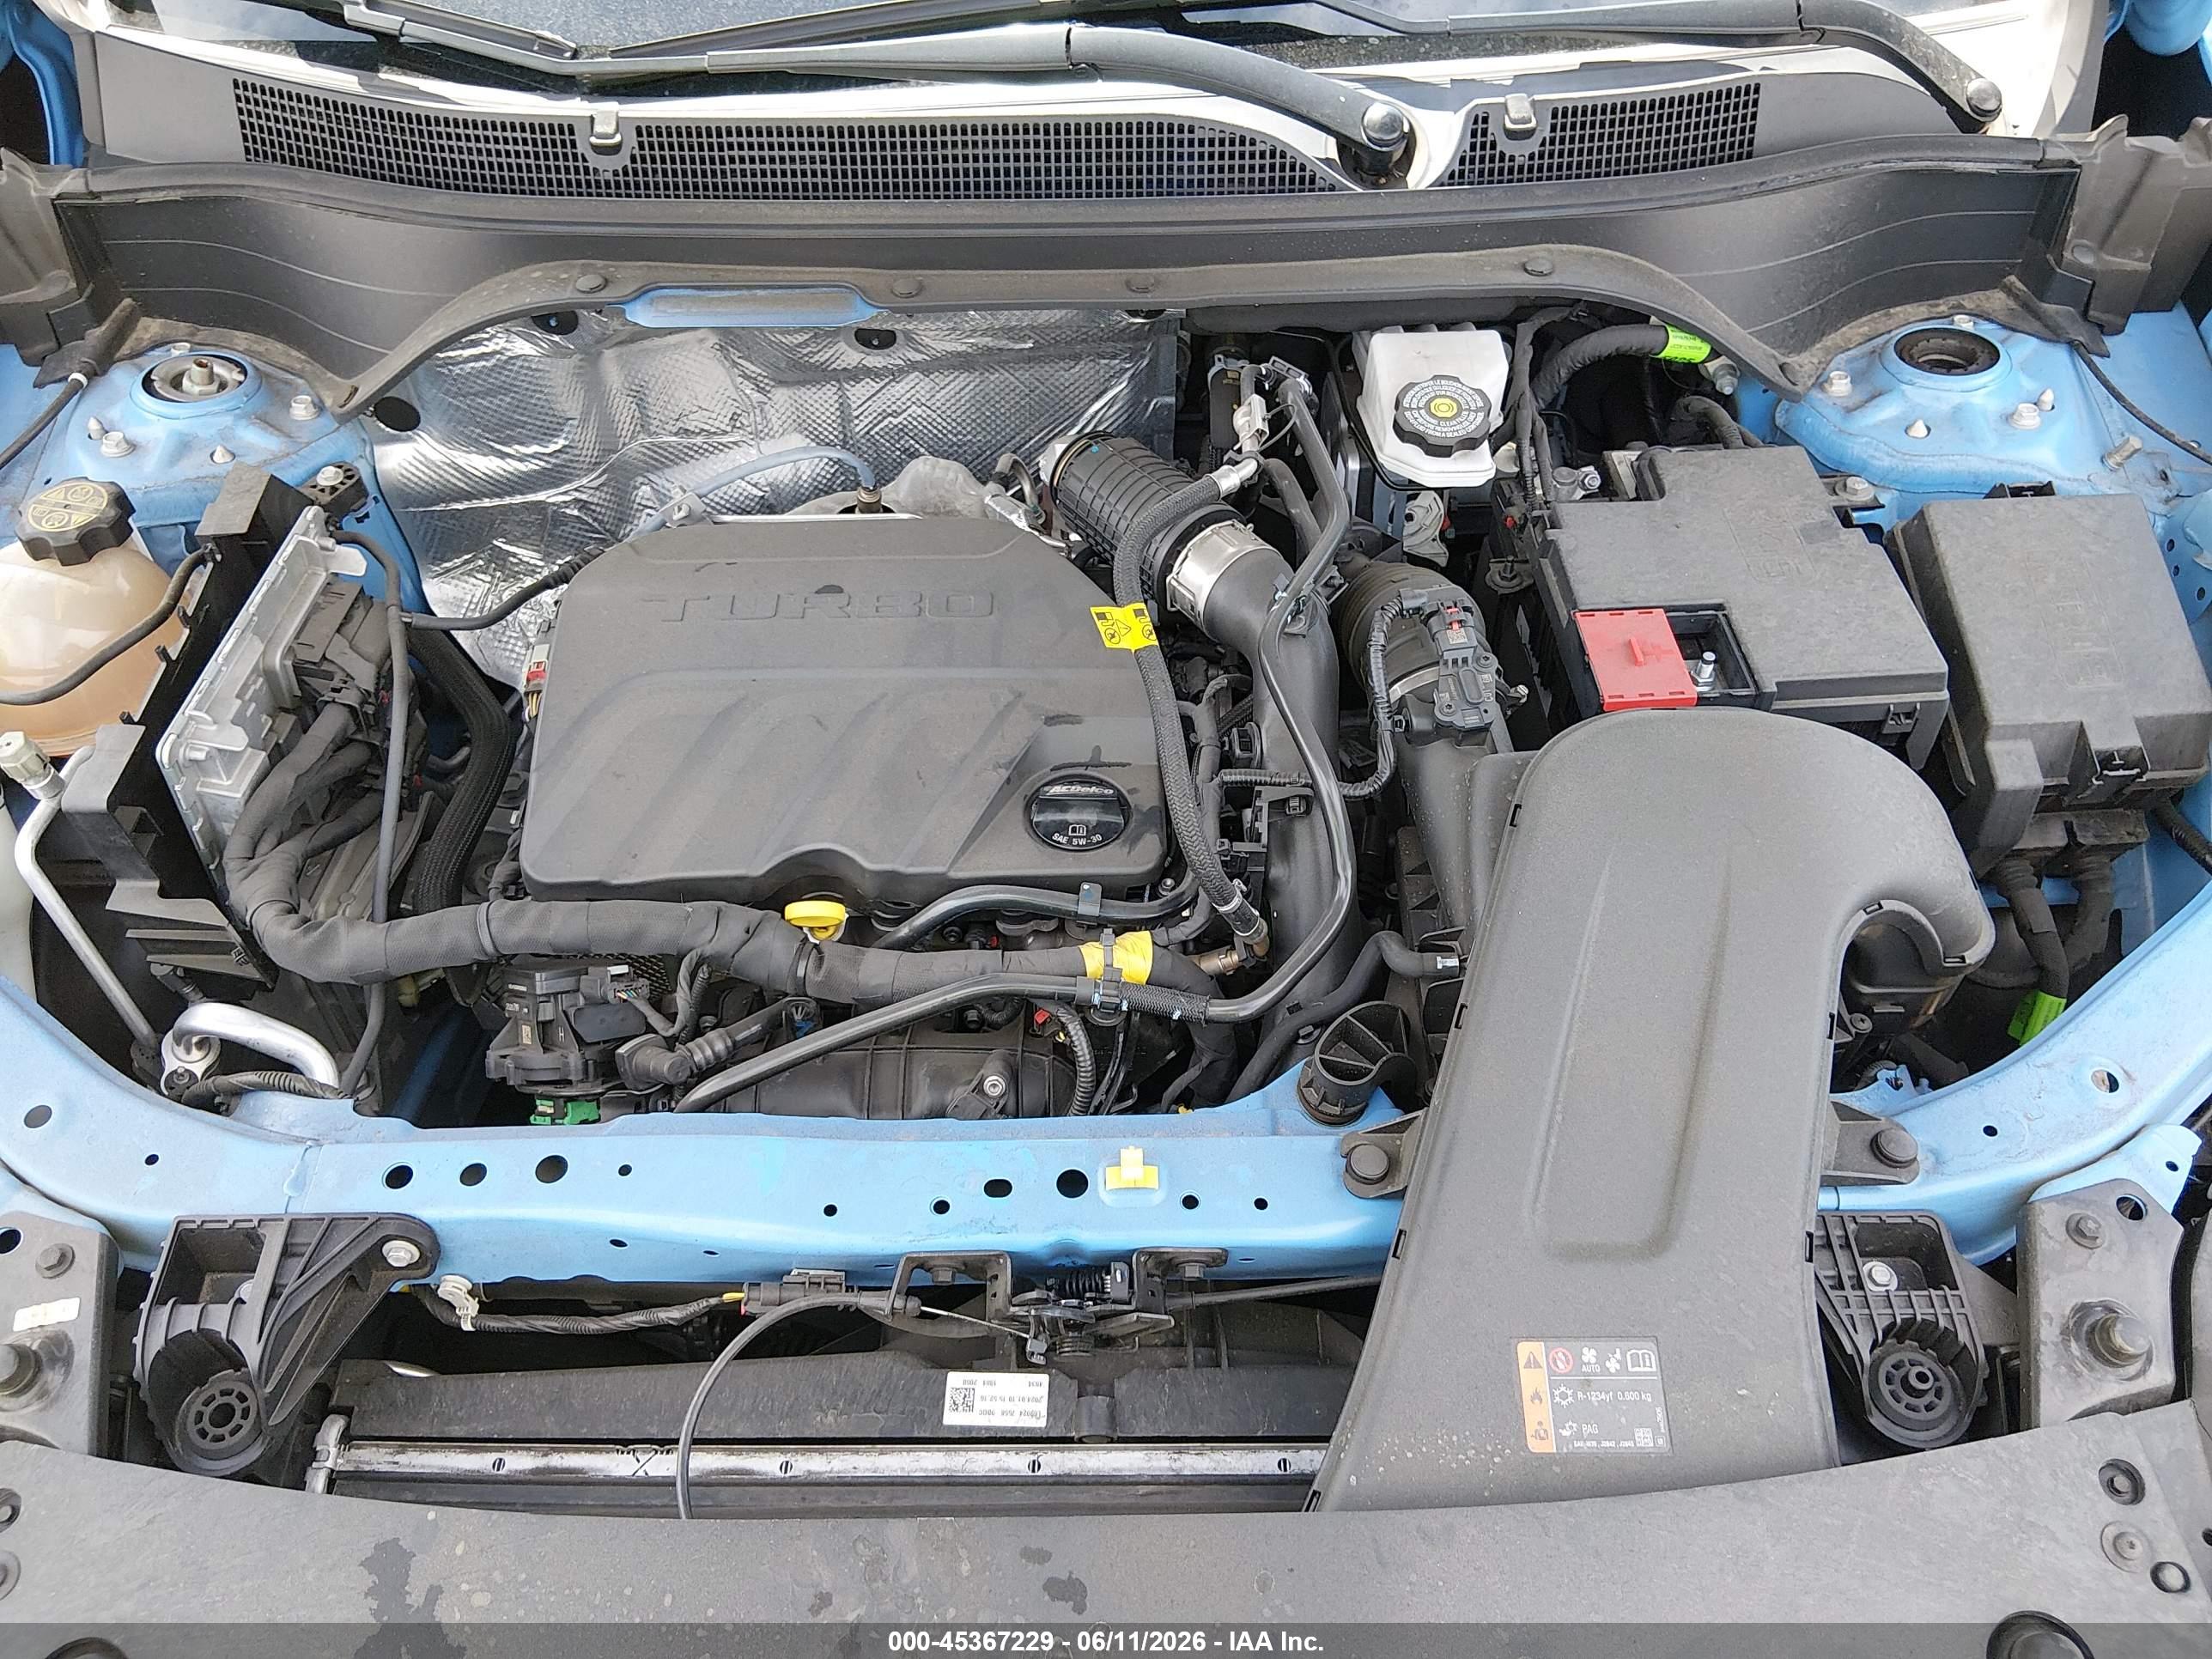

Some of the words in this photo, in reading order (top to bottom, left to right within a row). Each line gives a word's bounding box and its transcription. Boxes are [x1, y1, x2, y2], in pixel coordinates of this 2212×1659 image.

[641, 591, 994, 623] TURBO
[1052, 833, 1069, 845] SAE
[1072, 834, 1103, 846] 5W-30
[1581, 1364, 1601, 1373] AUTO
[1577, 1391, 1613, 1402] R-1234yf
[1641, 1391, 1652, 1402] kg
[1582, 1423, 1599, 1435] PAG
